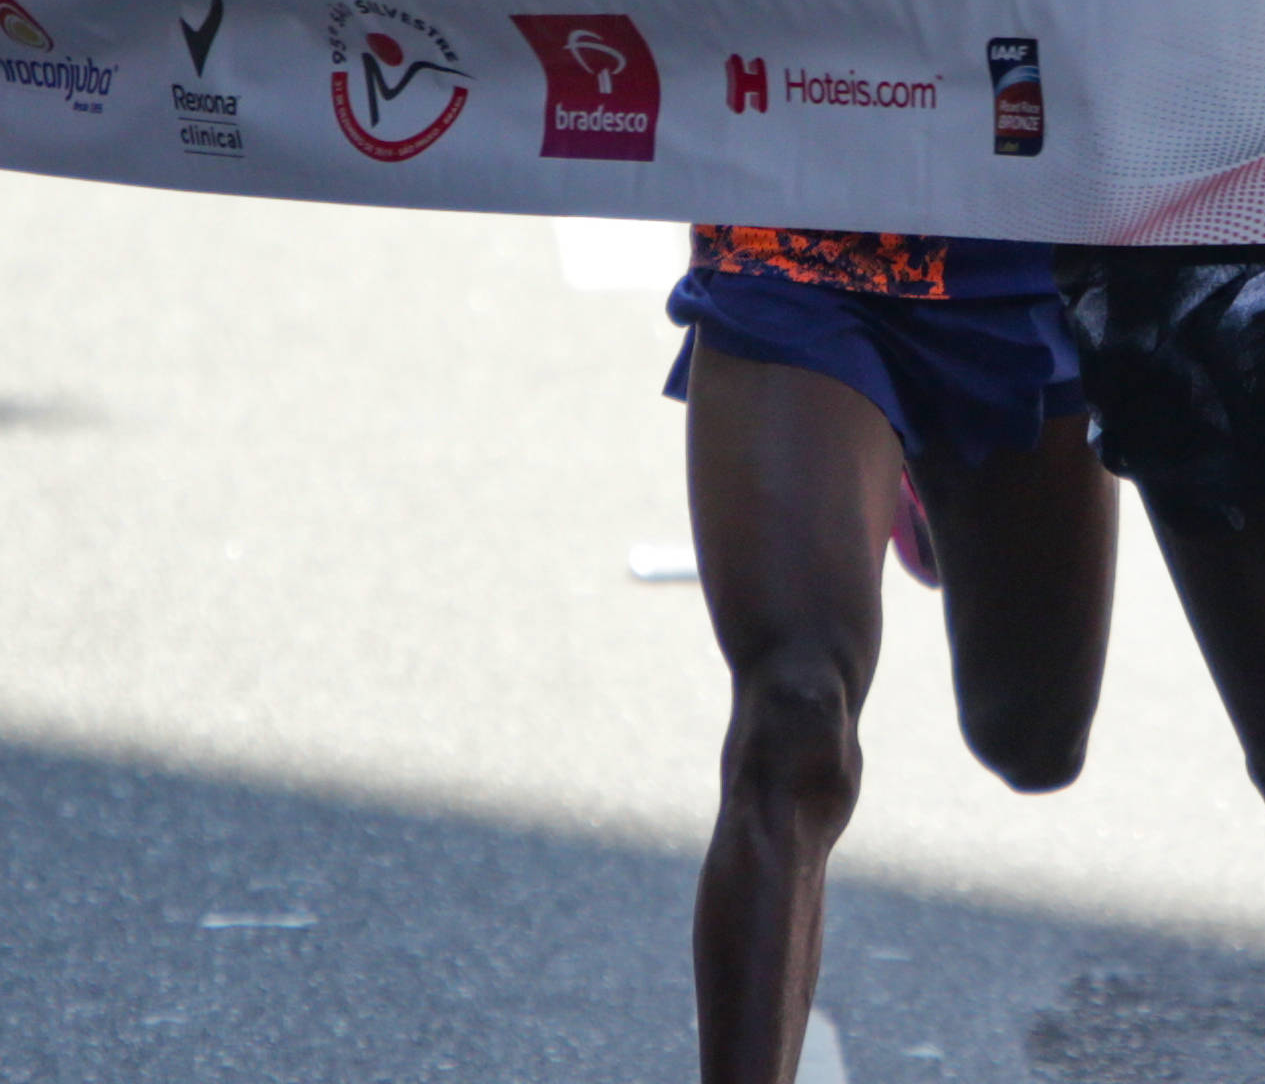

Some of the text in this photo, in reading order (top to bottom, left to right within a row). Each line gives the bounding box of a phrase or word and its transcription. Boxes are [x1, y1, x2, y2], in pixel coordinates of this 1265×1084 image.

[172, 83, 237, 116] Rexona
[555, 102, 648, 133] bradesco
[181, 125, 243, 149] clinical
